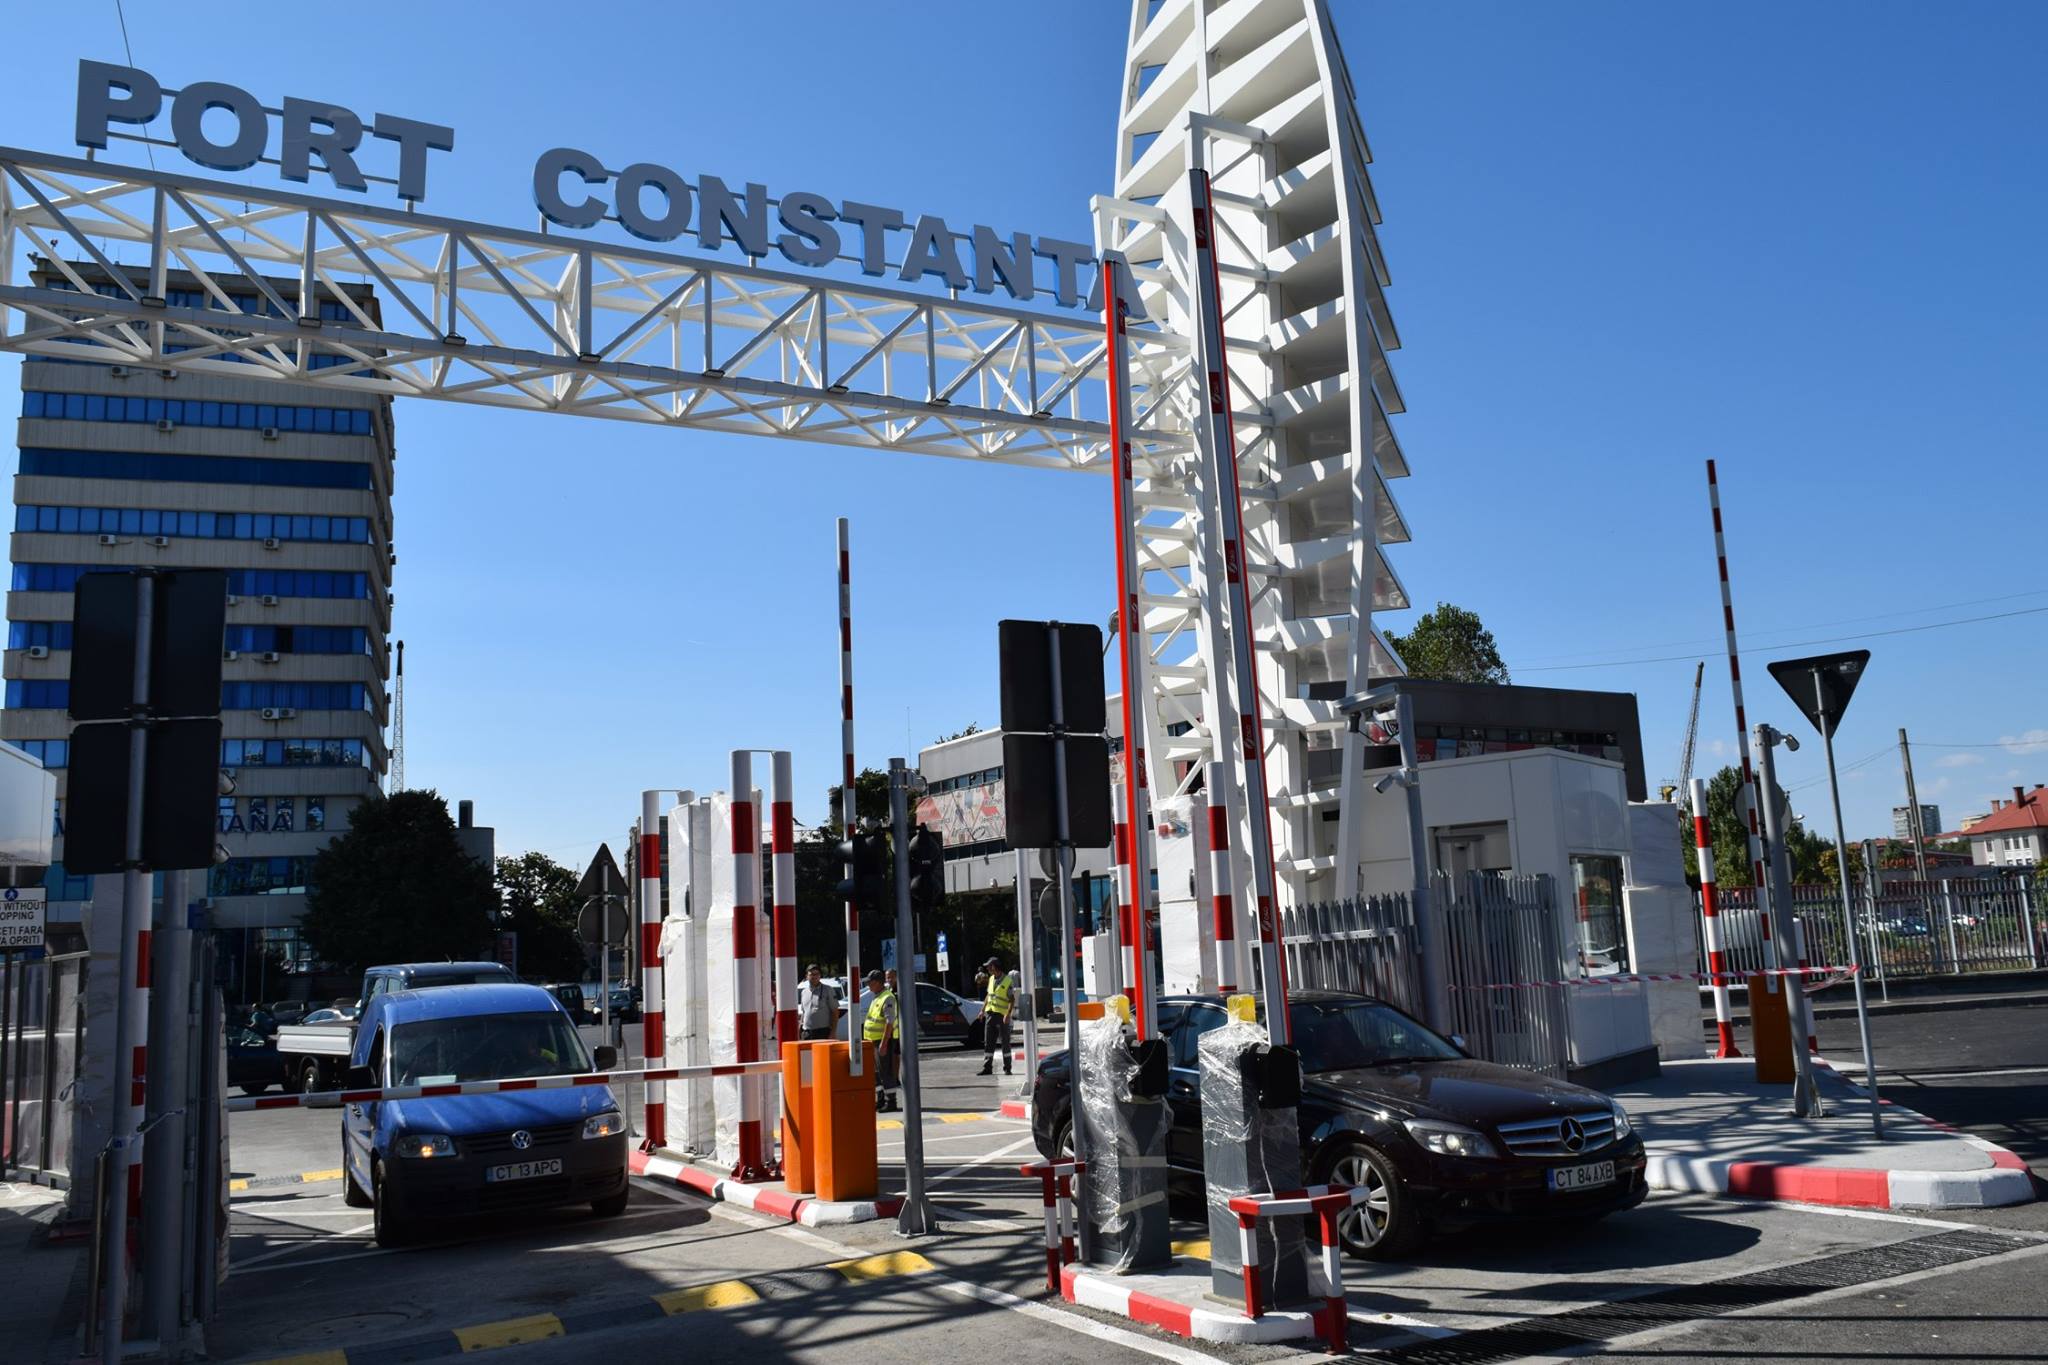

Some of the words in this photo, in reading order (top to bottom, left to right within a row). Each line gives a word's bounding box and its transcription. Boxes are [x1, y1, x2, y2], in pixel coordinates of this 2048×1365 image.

[75, 58, 454, 202] PORT
[533, 147, 1147, 319] CONSTANTA
[4, 902, 46, 911] WITHOUT
[0, 926, 16, 935] ETI
[19, 926, 43, 935] FARA
[9, 935, 40, 945] OPRITI
[496, 1165, 513, 1179] CT
[519, 1164, 530, 1176] 13
[534, 1160, 559, 1175] APC
[1556, 1169, 1573, 1187] CT
